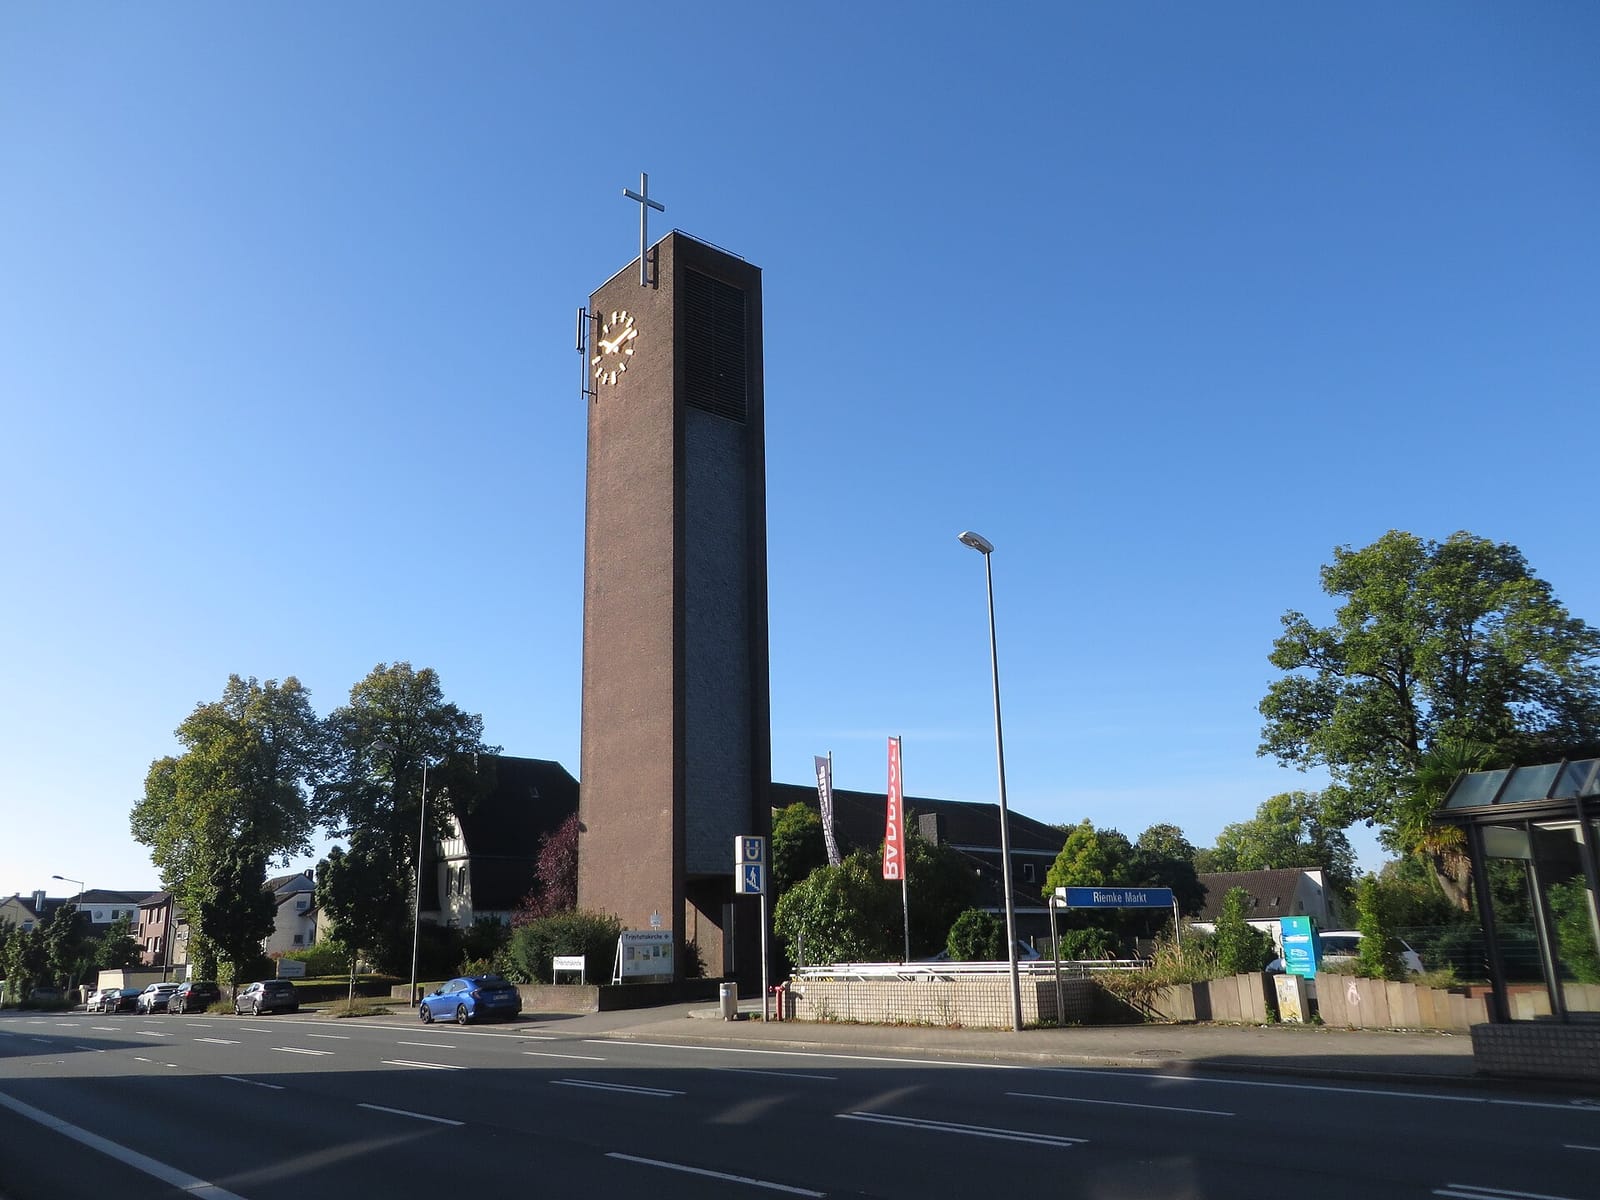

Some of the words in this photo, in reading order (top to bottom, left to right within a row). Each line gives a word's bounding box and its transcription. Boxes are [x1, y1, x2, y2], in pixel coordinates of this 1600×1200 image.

[746, 840, 759, 860] U
[1093, 891, 1122, 903] Riemke
[1124, 892, 1147, 903] Markt
